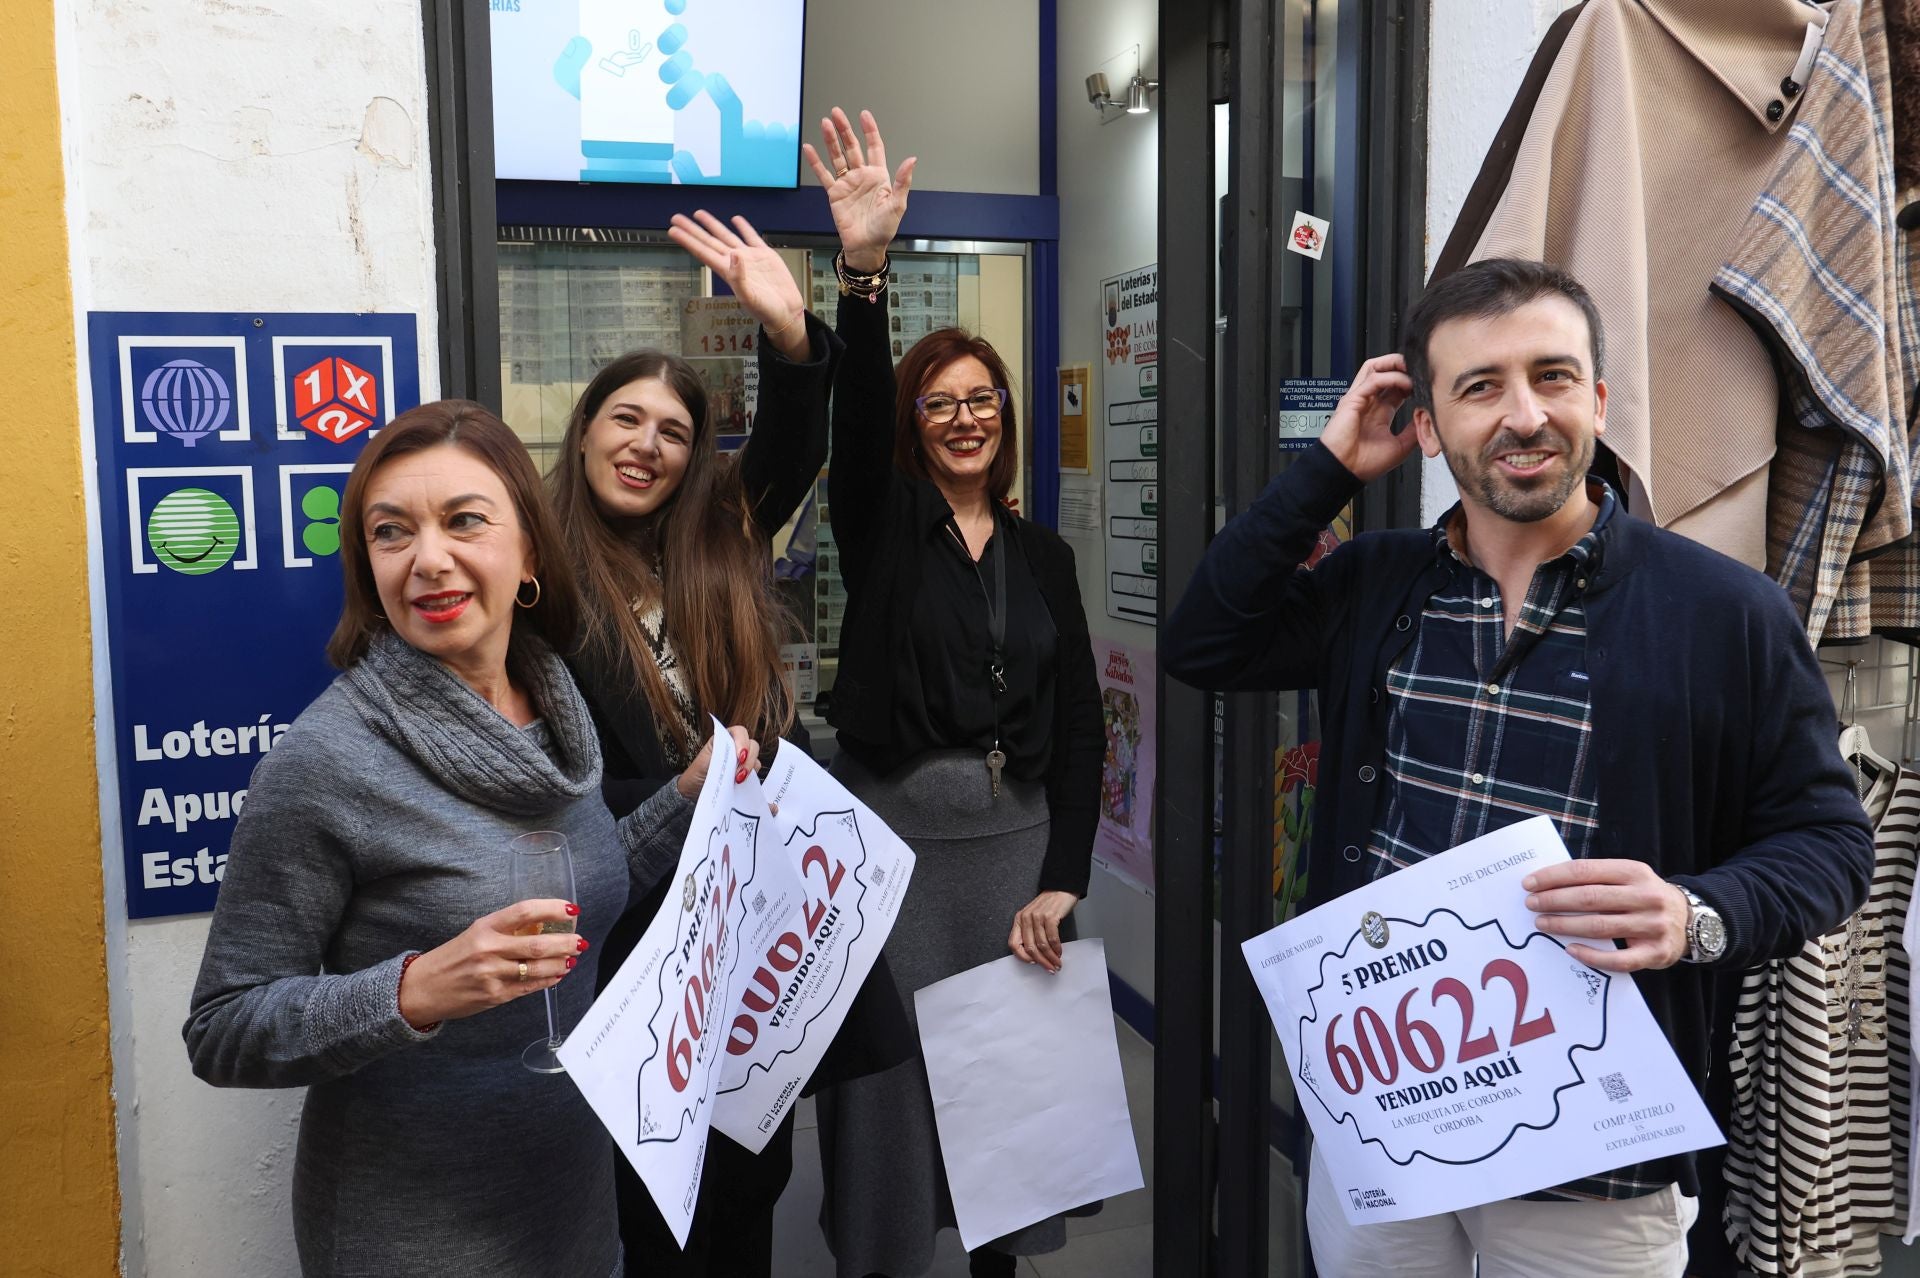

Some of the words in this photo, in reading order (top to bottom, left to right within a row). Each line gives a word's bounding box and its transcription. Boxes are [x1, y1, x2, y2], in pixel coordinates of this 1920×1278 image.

[1121, 272, 1151, 292] Loterías
[1121, 294, 1132, 311] del
[1447, 879, 1459, 891] 22
[1459, 872, 1476, 886] DE
[1475, 848, 1537, 879] DICIEMBRE
[675, 959, 684, 986] 5
[683, 859, 716, 964] PREMIO
[666, 843, 737, 1093] 60622
[769, 951, 816, 1028] VENDIDO
[814, 903, 841, 951] AQUÍ
[815, 961, 825, 978] DE
[821, 922, 845, 961] CORDOBA
[1341, 973, 1353, 996] 5
[1354, 938, 1448, 989] PREMIO
[810, 960, 834, 1000] CORDOBA
[1325, 958, 1557, 1096] 60622
[774, 1076, 802, 1116] NACIONAL
[1375, 1076, 1458, 1112] VENDIDO
[1463, 1050, 1522, 1088] AQUÍ
[1391, 1118, 1404, 1129] LA
[1403, 1106, 1452, 1126] MEZQUITA
[1451, 1101, 1468, 1113] DE
[1467, 1086, 1522, 1109] CORDOBA
[1433, 1114, 1484, 1135] CORDOBA
[1593, 1102, 1675, 1132] COMPARTIRLO
[1605, 1124, 1686, 1151] EXTRAORDINARIO
[1361, 1187, 1387, 1200] LOTERÍA
[1365, 1196, 1397, 1208] NACIONAL
